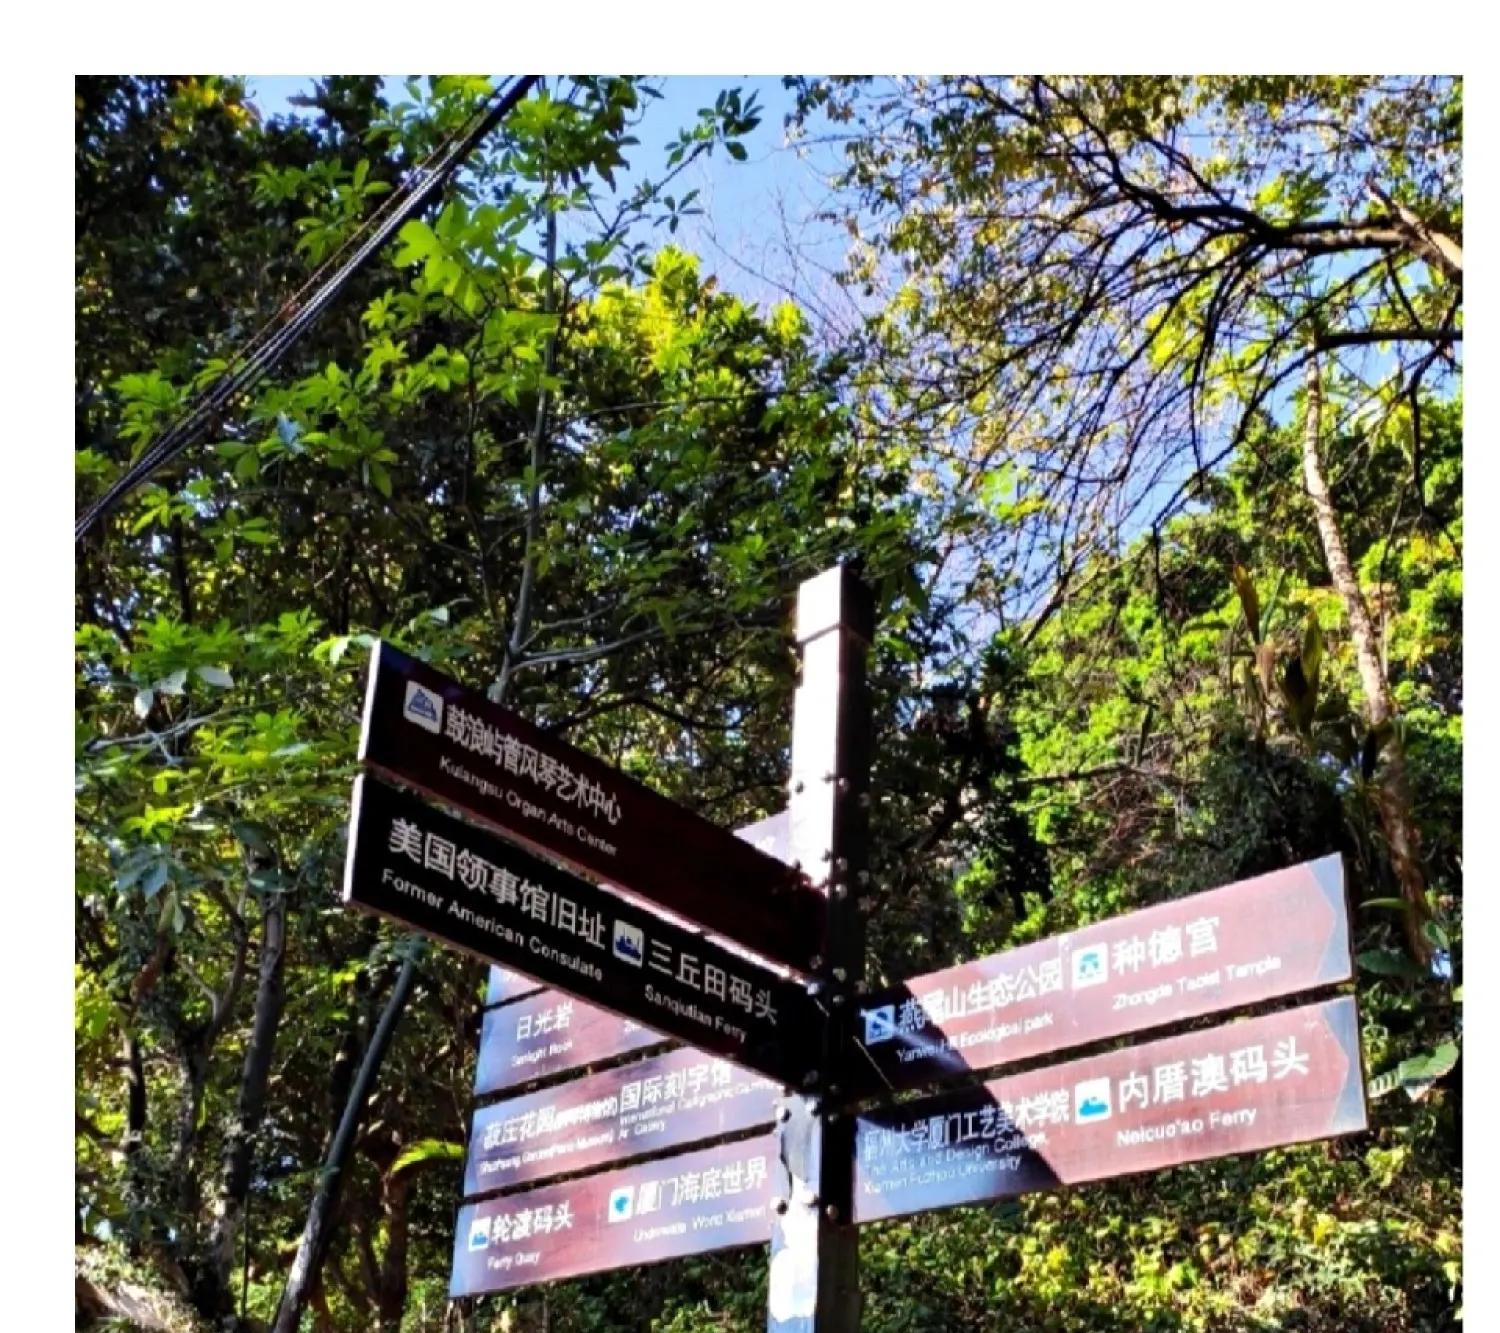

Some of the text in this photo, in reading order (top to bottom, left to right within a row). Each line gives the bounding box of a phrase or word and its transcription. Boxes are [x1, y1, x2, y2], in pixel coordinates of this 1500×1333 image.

[444, 704, 623, 826] 鼓浪屿管风琴艺术中心
[439, 756, 618, 857] Kulangsu Organ Arts Center
[388, 817, 607, 951] 美国领事馆旧址
[382, 868, 603, 981] Former American Consulate
[1112, 916, 1221, 973] 种德宫
[648, 938, 779, 1026] 三丘田码头
[1225, 956, 1283, 984] Temple
[516, 1001, 574, 1042] 日光岩
[714, 1014, 748, 1043] Ferry
[1209, 1107, 1258, 1133] Ferry
[636, 1155, 768, 1216] 厦门海底世界
[492, 1202, 575, 1245] 轮渡码头
